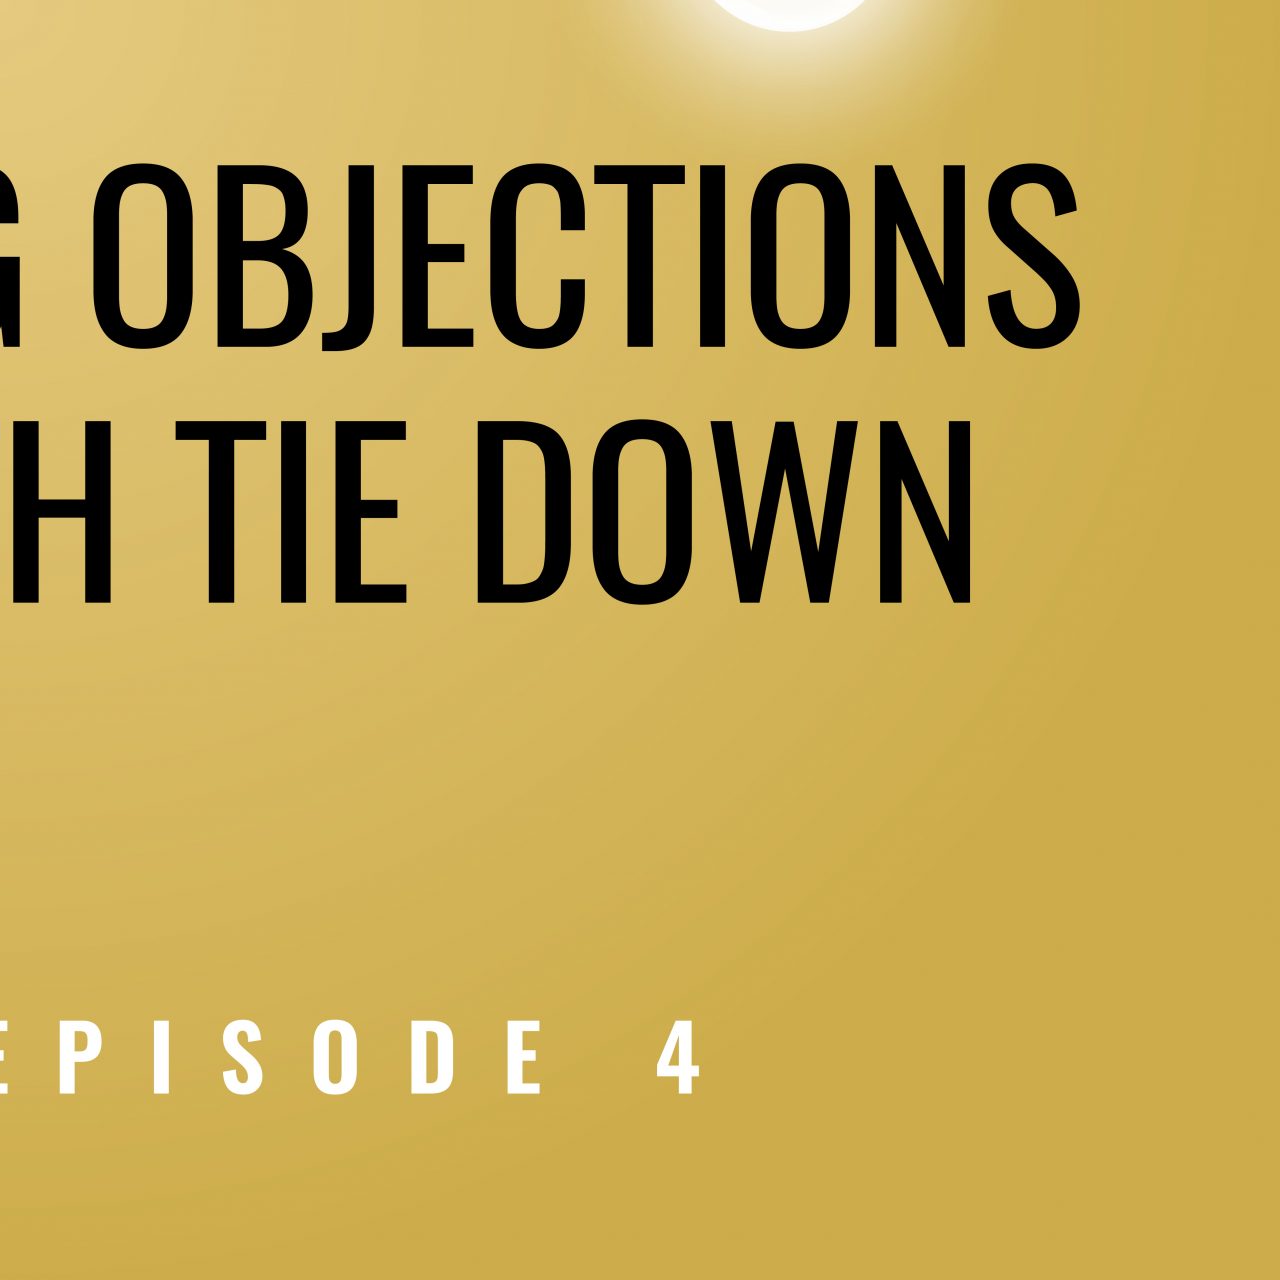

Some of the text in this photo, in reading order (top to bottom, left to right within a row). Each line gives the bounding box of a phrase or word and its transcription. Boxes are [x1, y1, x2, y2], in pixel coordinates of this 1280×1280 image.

[90, 164, 1082, 351] OBJECTIONS
[176, 421, 408, 604] TIE
[476, 419, 973, 605] DOWN
[657, 1021, 700, 1094] 4
